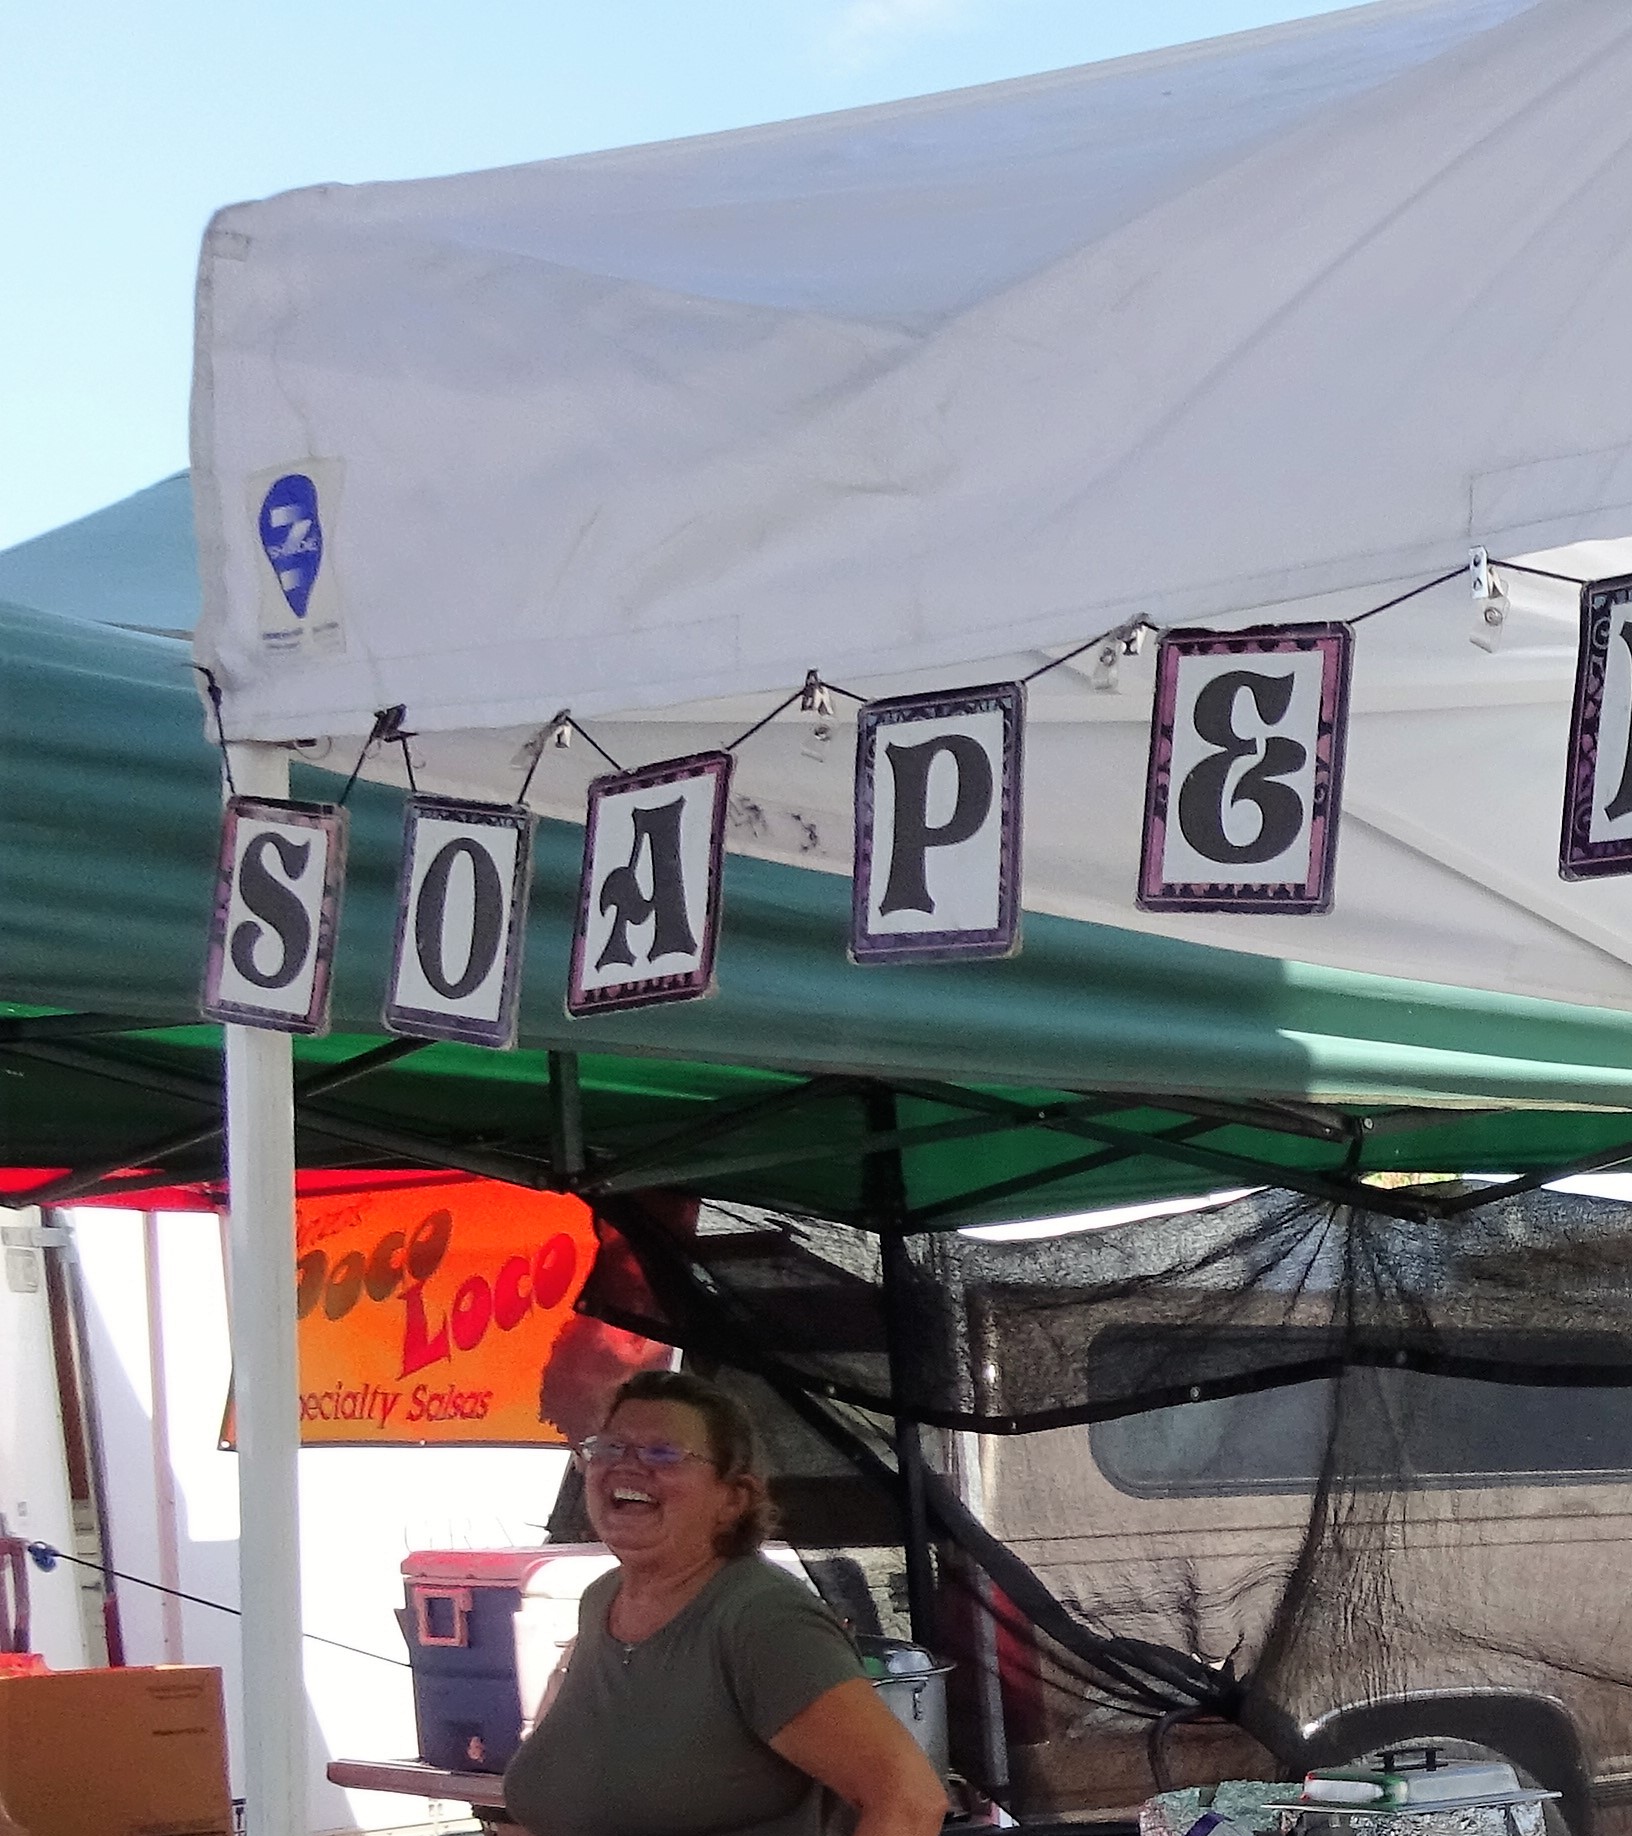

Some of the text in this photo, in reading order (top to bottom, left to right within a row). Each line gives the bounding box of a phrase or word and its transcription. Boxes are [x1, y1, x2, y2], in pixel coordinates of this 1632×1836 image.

[229, 732, 993, 998] SOAP
[1177, 669, 1308, 866] &
[396, 1233, 577, 1380] Loco
